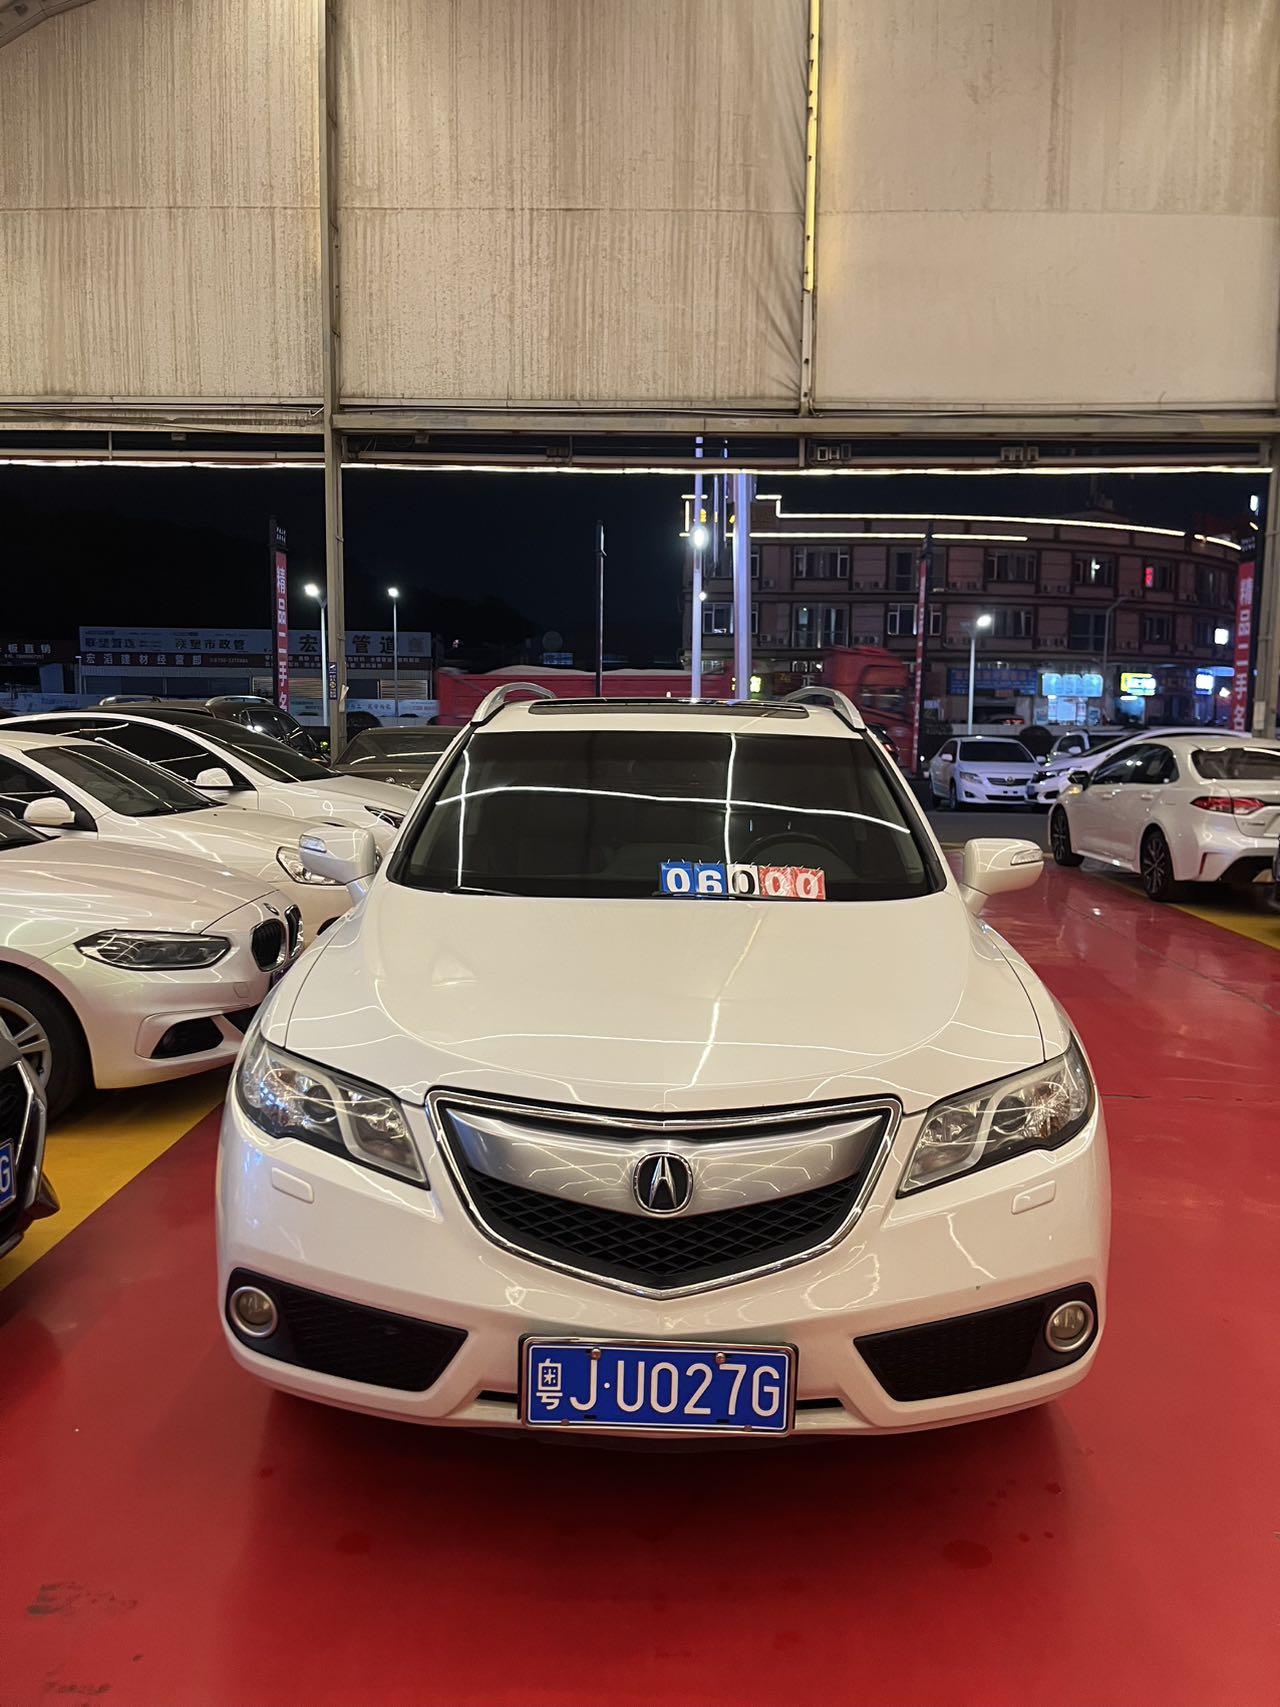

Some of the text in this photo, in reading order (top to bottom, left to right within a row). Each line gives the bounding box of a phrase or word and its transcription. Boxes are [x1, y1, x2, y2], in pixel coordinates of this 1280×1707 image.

[299, 634, 397, 654] 宏管道
[535, 1357, 780, 1418] 粤J·U027G
